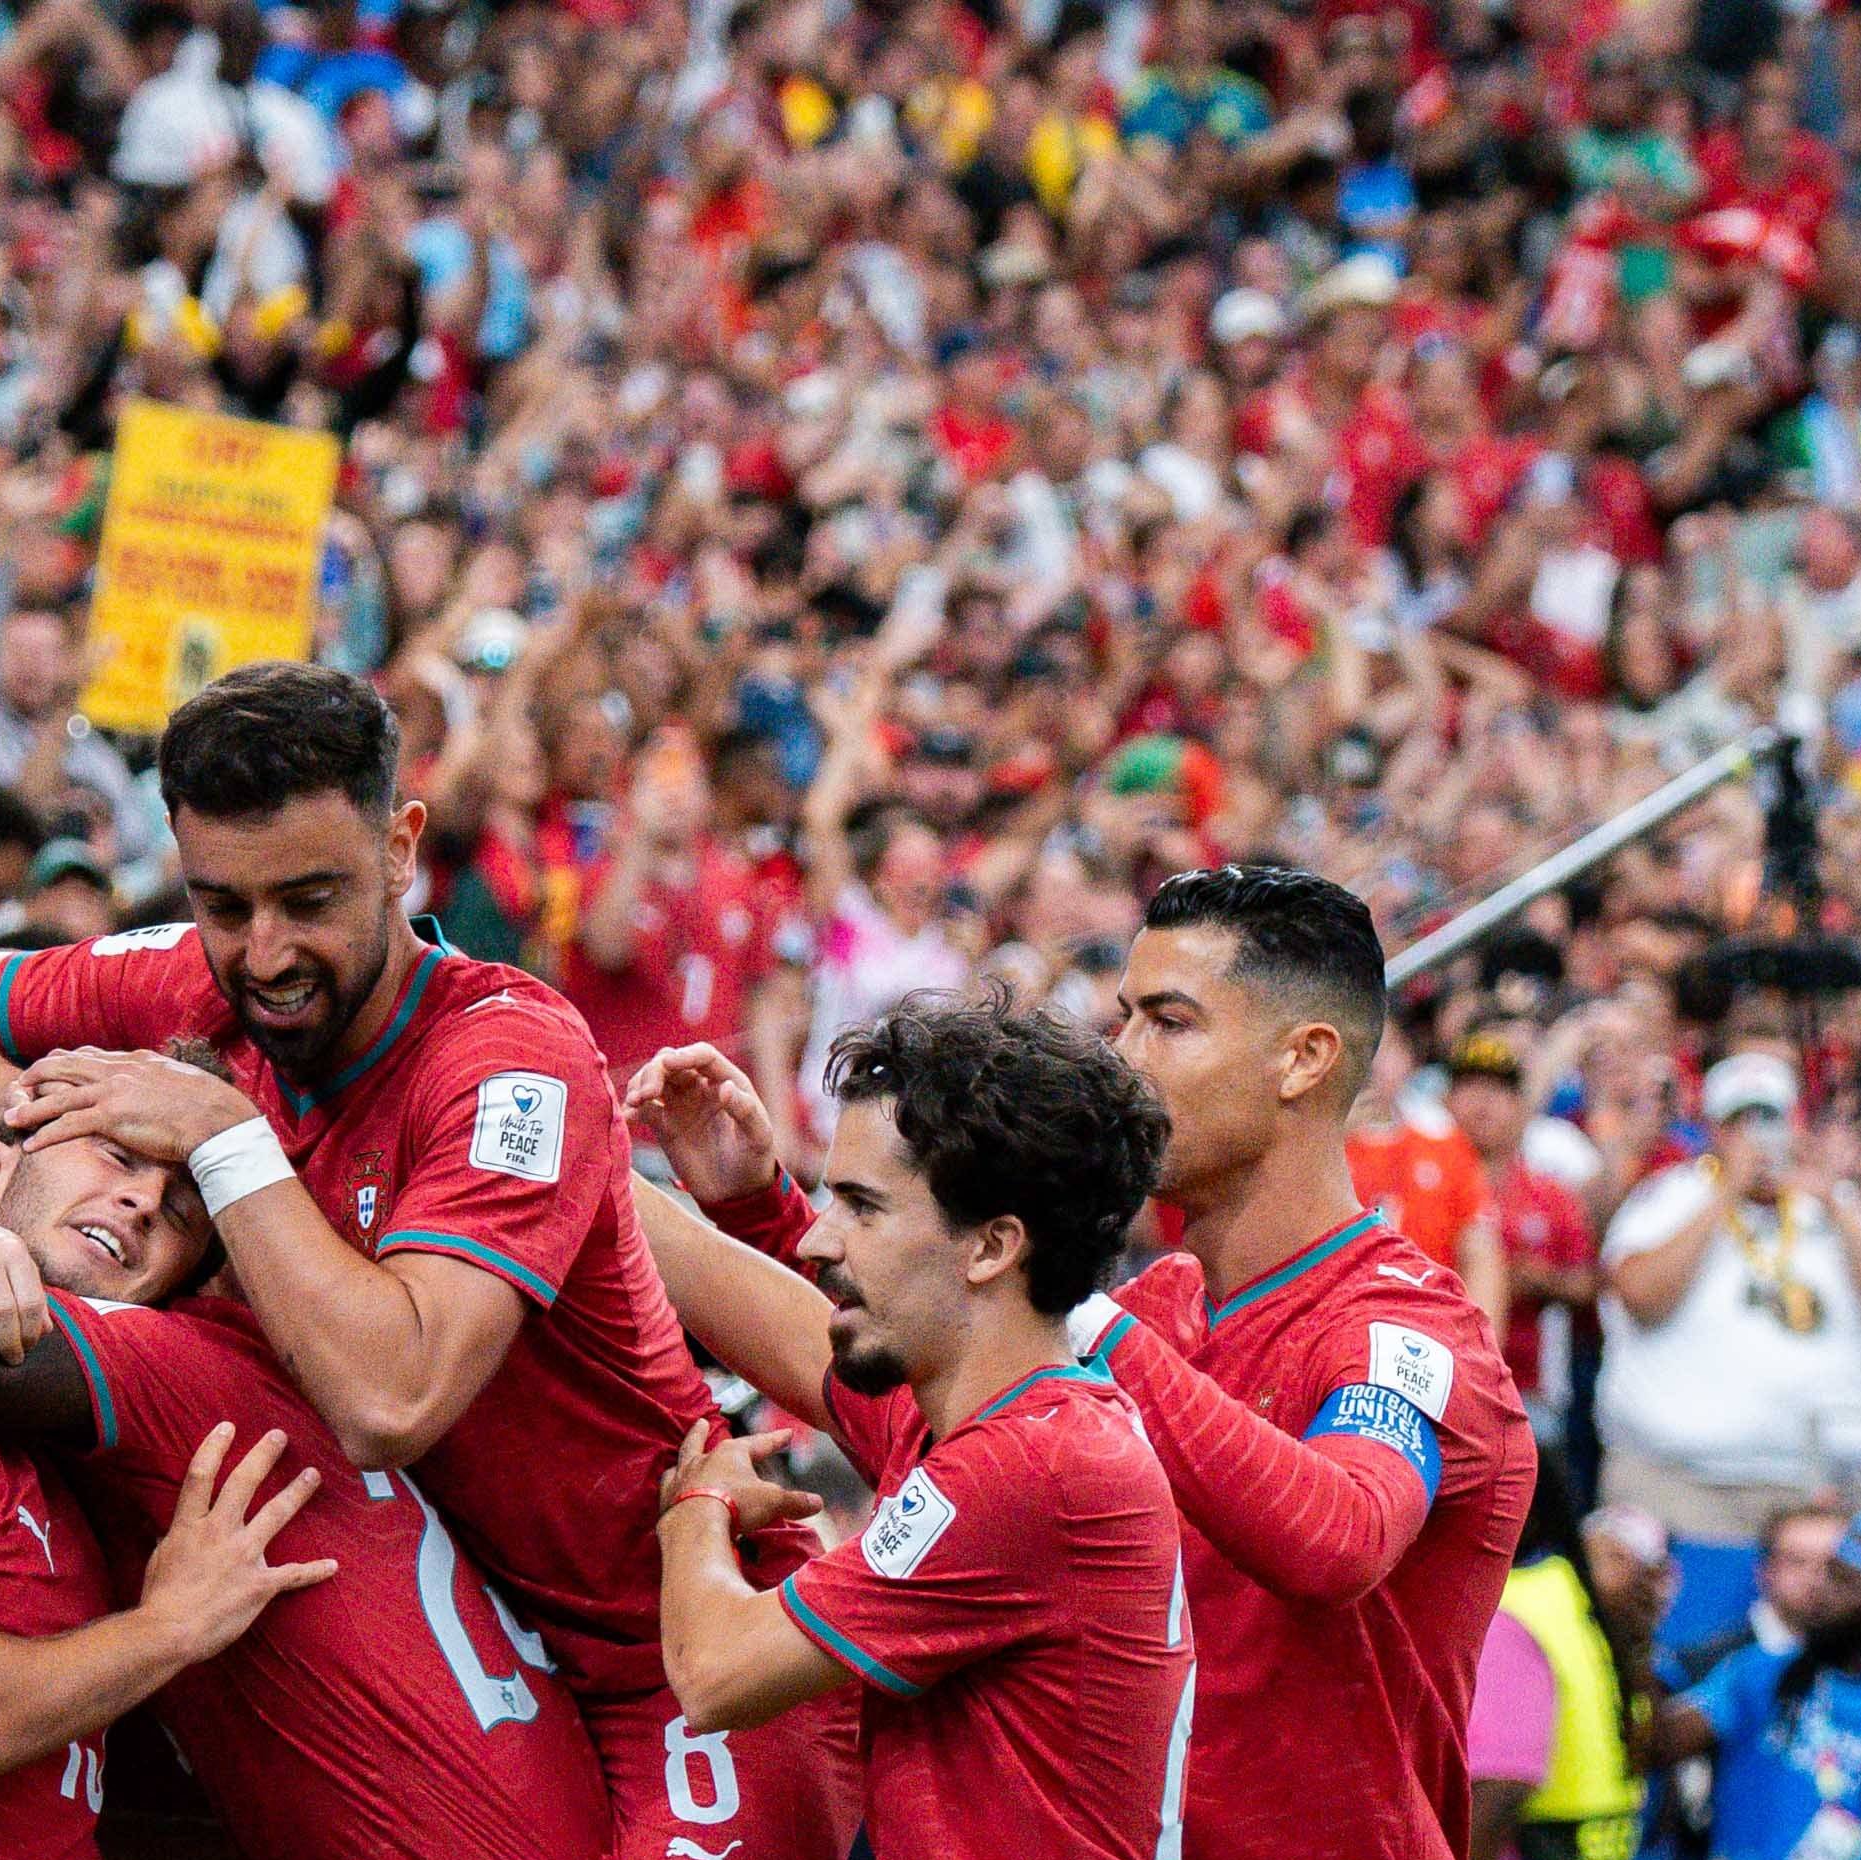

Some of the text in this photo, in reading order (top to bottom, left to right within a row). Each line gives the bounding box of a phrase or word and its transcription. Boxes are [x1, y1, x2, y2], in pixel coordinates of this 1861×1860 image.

[500, 1113, 544, 1136] Unite For
[500, 1131, 539, 1156] PEACE
[506, 1152, 526, 1165] FIFA
[1396, 1366, 1431, 1393] PEACE
[1341, 1384, 1421, 1430] FOOTBALL
[361, 1469, 558, 1736] 2
[665, 1714, 740, 1825] 8
